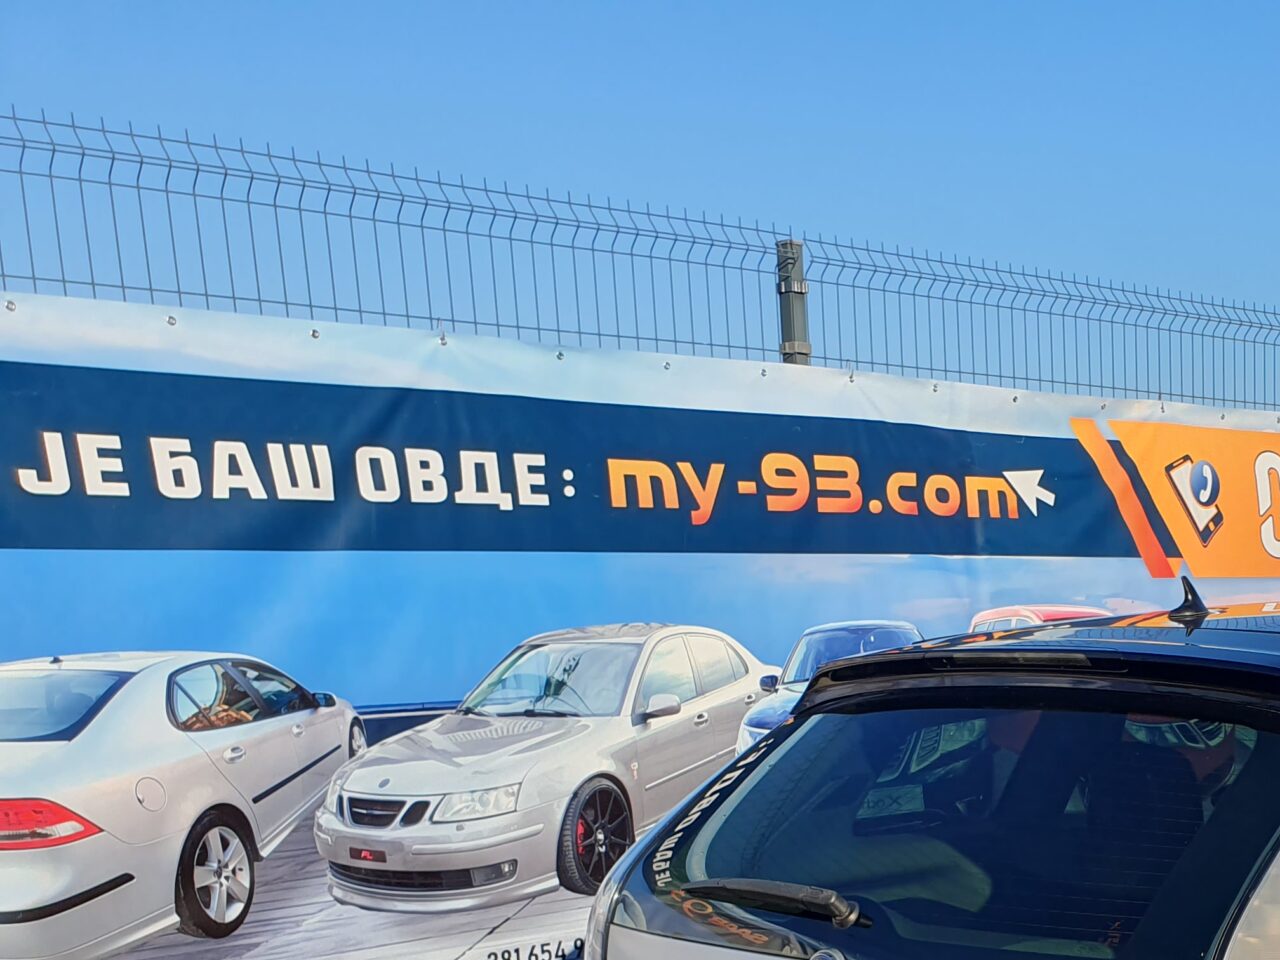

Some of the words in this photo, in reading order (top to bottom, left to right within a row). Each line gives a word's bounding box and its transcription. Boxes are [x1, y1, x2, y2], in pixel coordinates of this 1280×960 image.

[17, 431, 131, 497] ЈЕ
[149, 437, 336, 501] БАШ
[606, 452, 1020, 526] my-93.com
